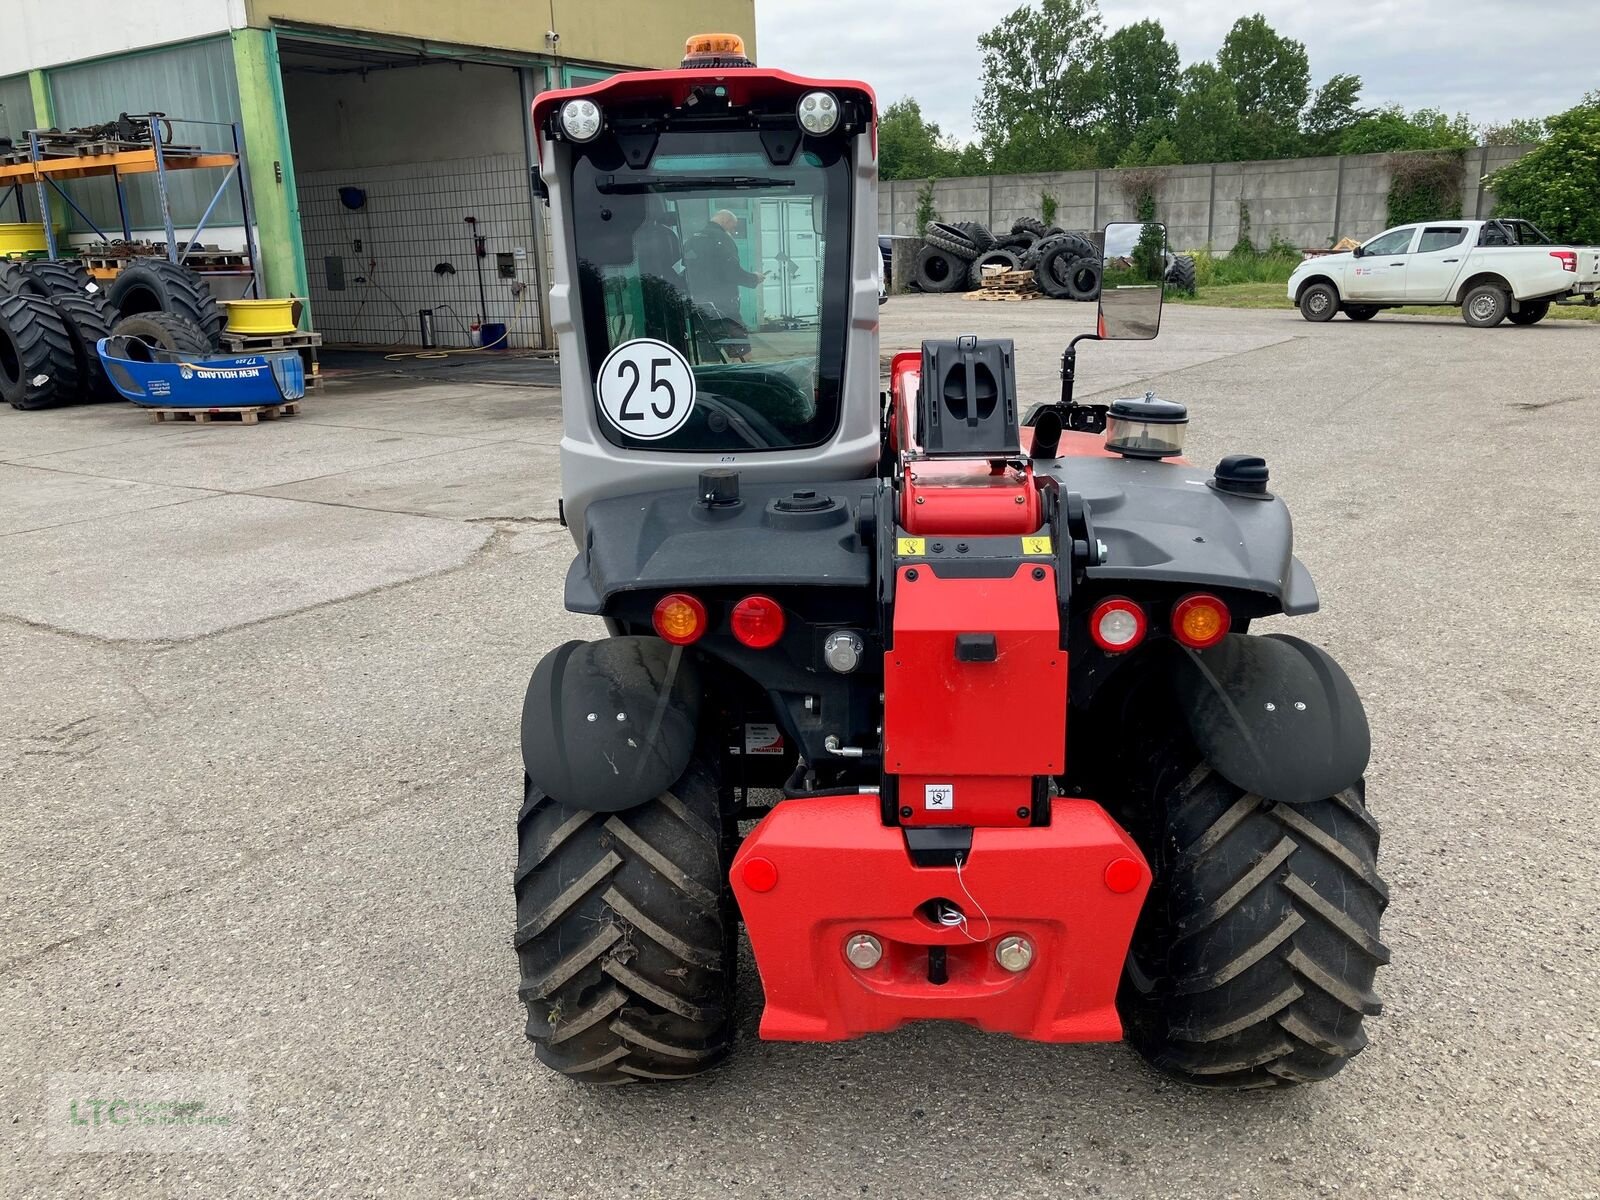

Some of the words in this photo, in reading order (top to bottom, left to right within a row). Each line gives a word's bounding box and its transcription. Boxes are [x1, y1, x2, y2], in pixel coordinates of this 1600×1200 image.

[197, 370, 238, 378] HOLLAND
[239, 369, 259, 378] NEW
[618, 358, 676, 421] 25
